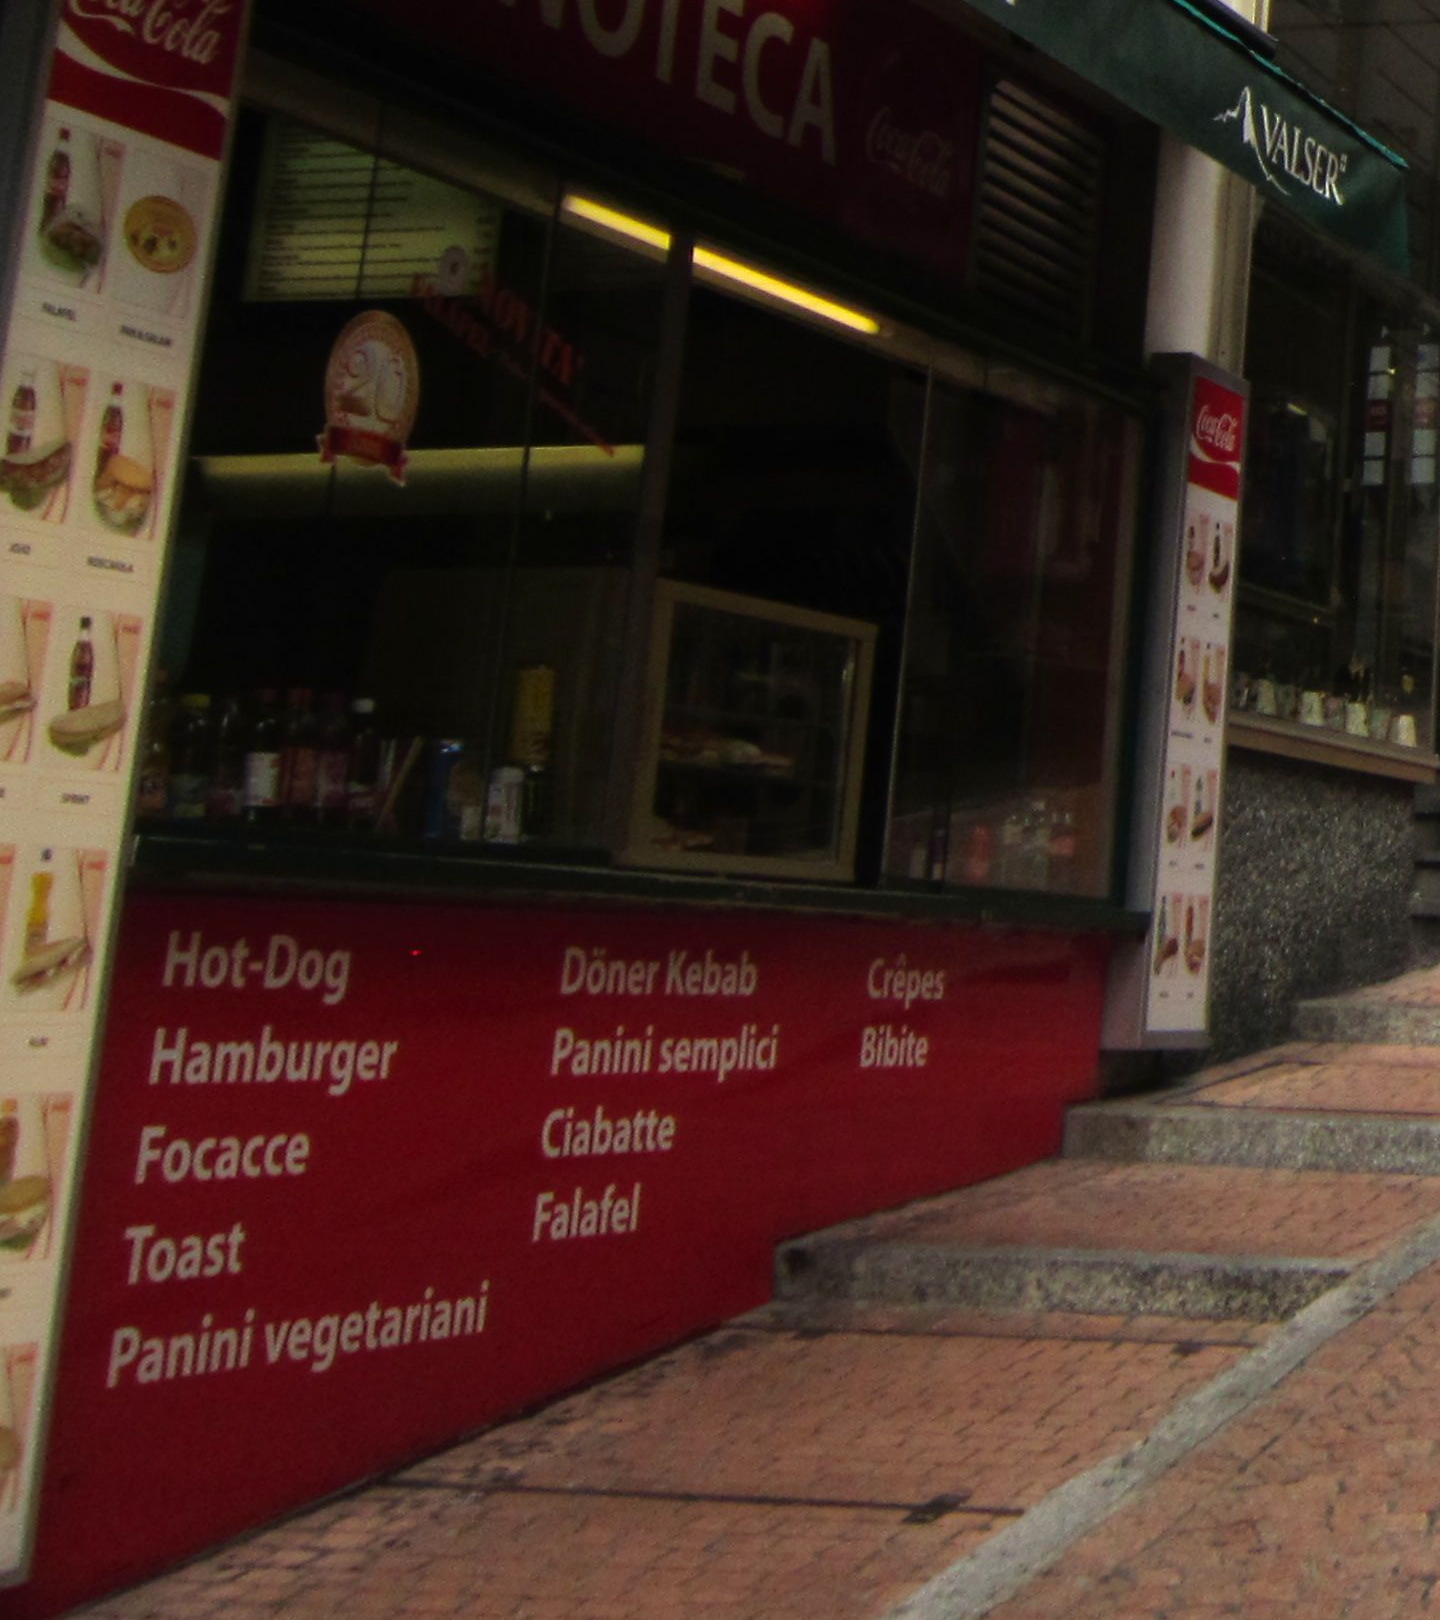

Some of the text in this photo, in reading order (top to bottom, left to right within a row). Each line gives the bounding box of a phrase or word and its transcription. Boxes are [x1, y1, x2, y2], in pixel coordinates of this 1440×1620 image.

[1261, 104, 1343, 206] VALSER
[162, 931, 351, 1005] Hot-Dog
[559, 945, 758, 997] Döner Kebab
[867, 953, 946, 1009] Crêpes
[149, 1025, 398, 1096] Hamburger
[550, 1025, 779, 1083] Panini semplici
[859, 1026, 929, 1068] Bibite
[134, 1125, 310, 1185] Focacce
[541, 1105, 677, 1159] Ciabatte
[531, 1182, 641, 1243] Falafel
[123, 1221, 246, 1285] Toast
[105, 1281, 491, 1389] Panini vegetariani
